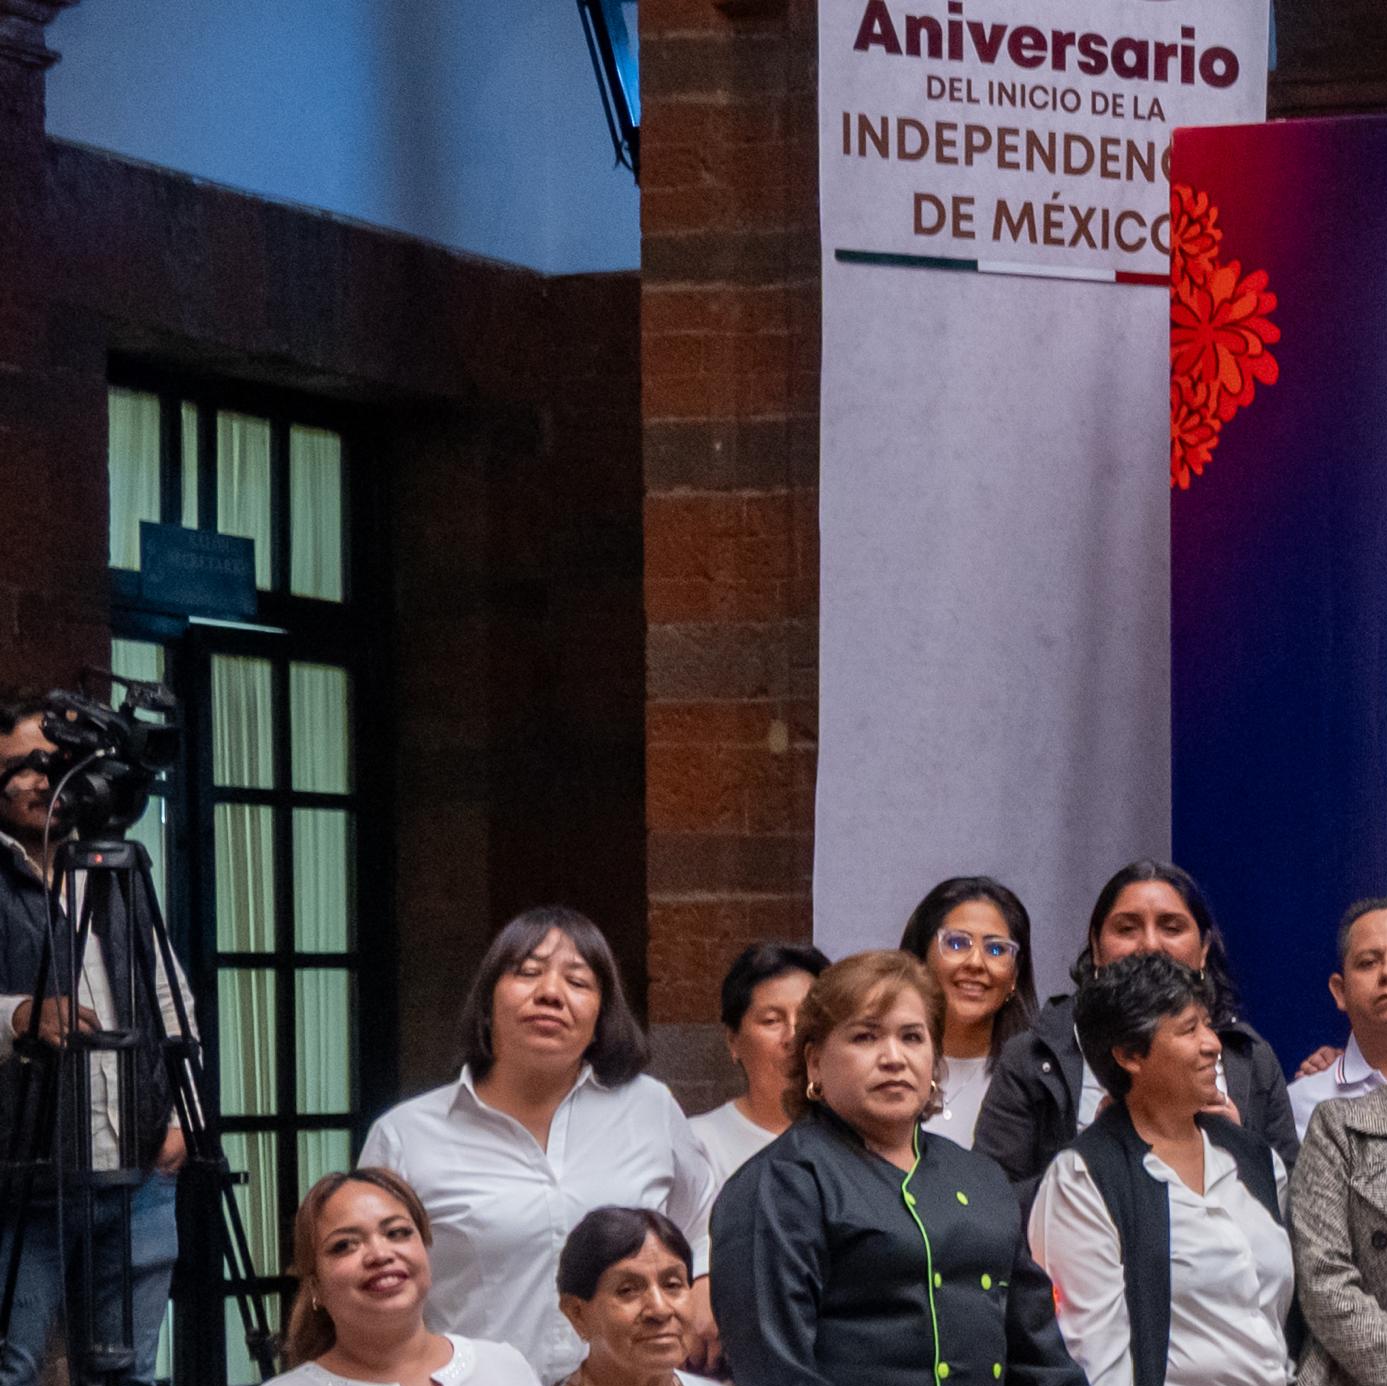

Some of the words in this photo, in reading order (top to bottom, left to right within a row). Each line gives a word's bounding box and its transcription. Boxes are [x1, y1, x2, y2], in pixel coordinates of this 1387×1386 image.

[853, 0, 1240, 89] Aniversario
[926, 75, 979, 102] DEL
[988, 80, 1082, 114] INICIO
[1091, 92, 1123, 118] DE
[1132, 97, 1166, 122] LA
[841, 111, 1171, 183] INDEPENDEN
[913, 192, 976, 238] DE
